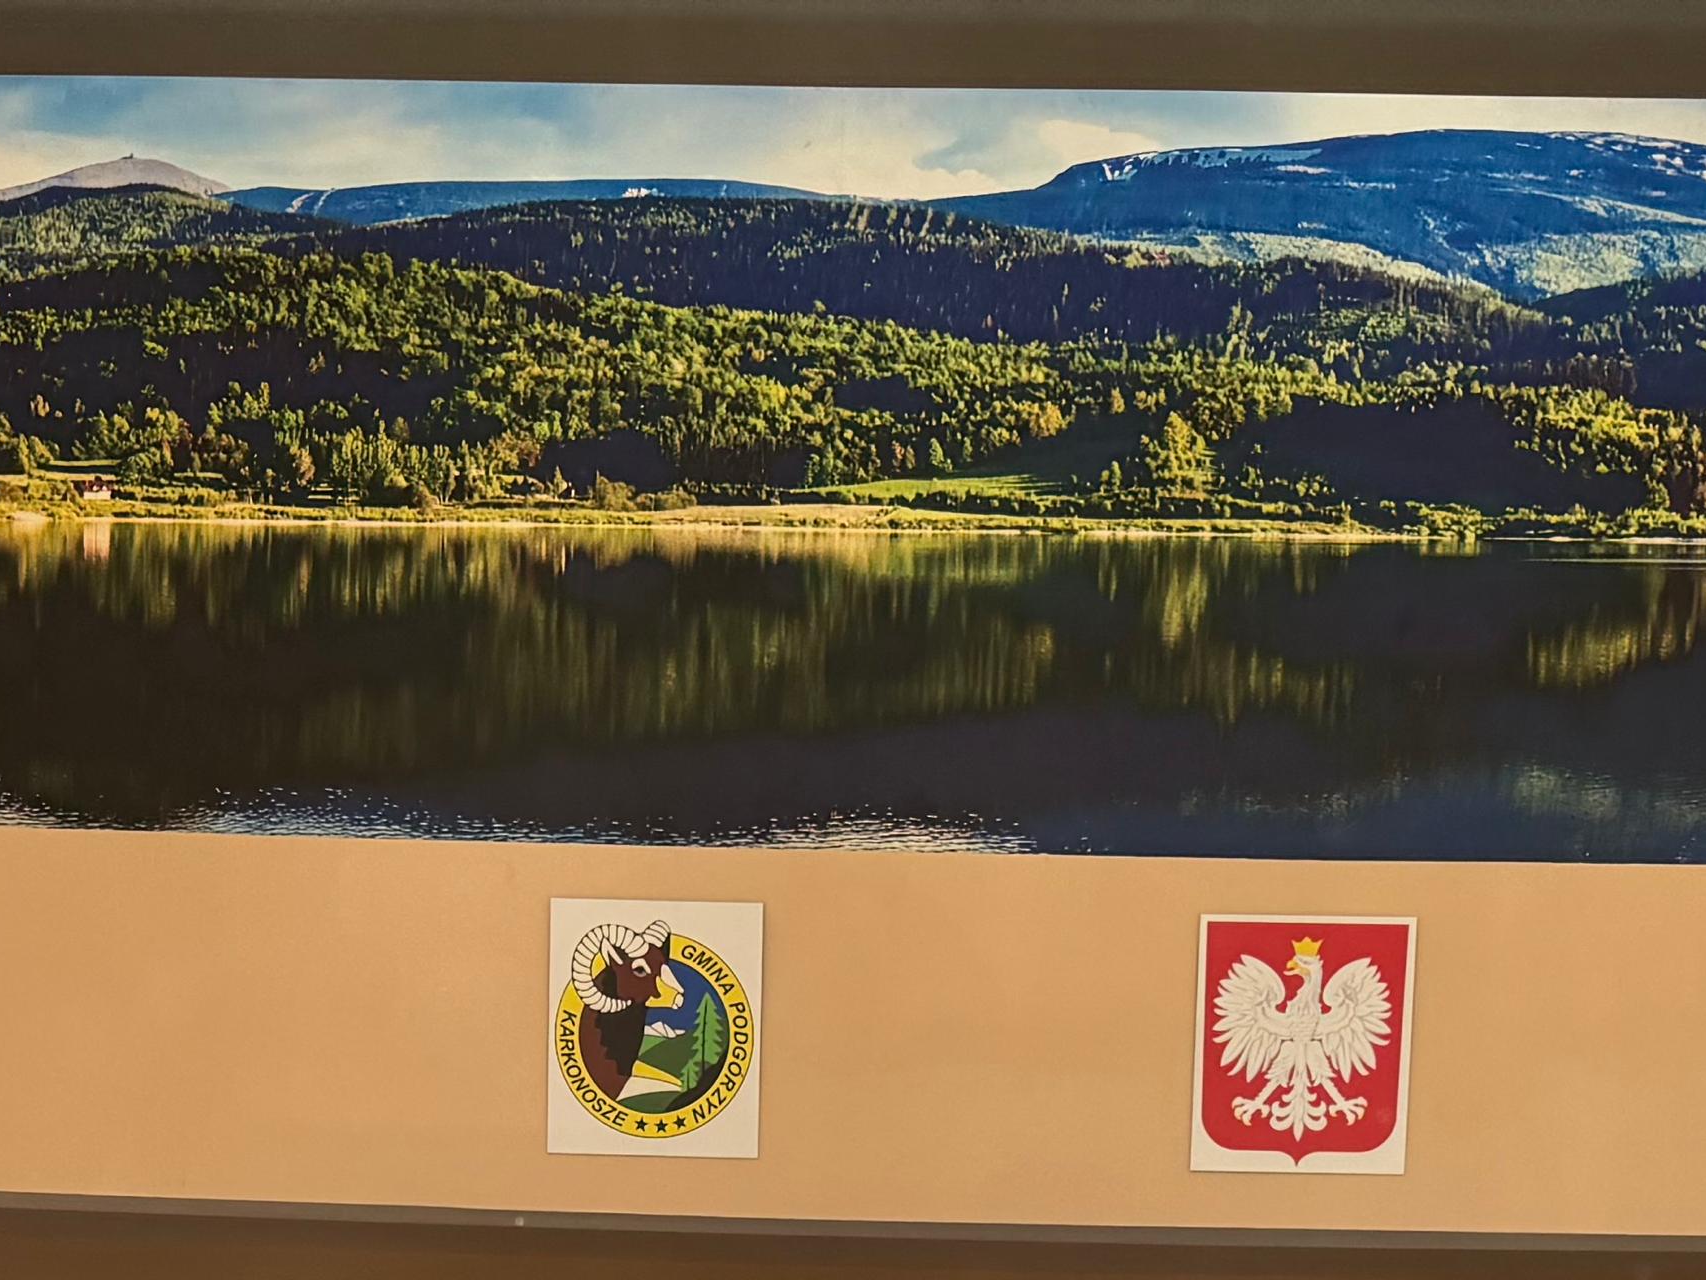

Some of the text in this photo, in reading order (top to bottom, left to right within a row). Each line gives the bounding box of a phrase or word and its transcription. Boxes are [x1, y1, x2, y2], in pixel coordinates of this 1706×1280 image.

[559, 1009, 629, 1128] KARKONOSZE
[681, 944, 750, 1123] GMINA PODGÓRZYN
